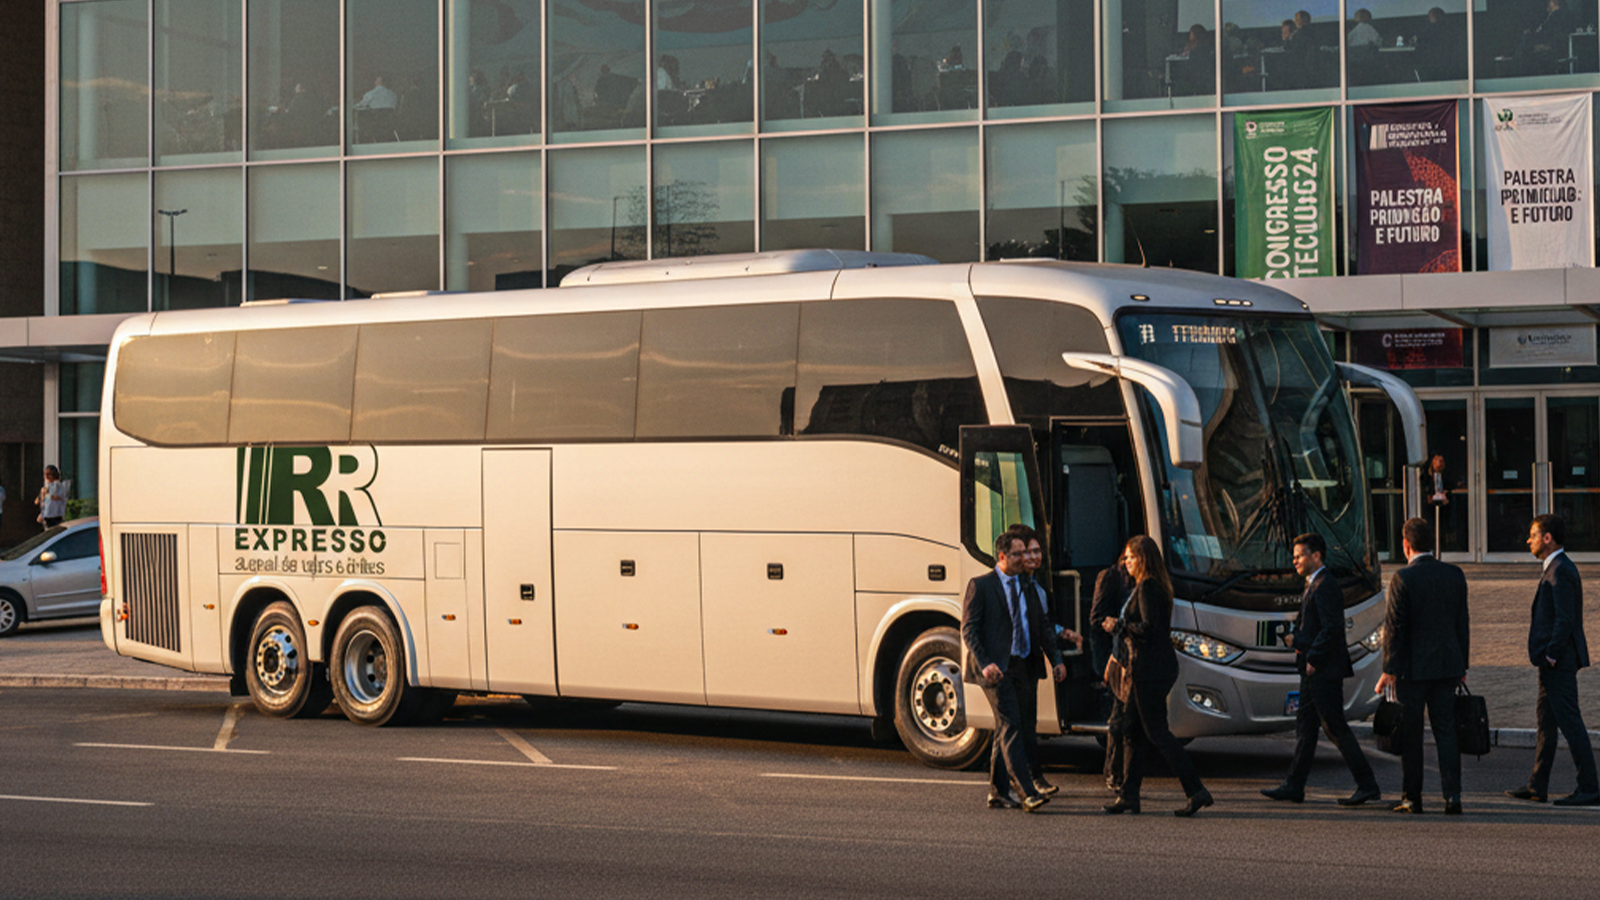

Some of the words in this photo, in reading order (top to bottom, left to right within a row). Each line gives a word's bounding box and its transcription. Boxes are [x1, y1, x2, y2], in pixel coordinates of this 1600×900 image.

[1503, 168, 1576, 185] PALESTRA
[1370, 187, 1443, 206] PALESTRA
[1511, 207, 1519, 224] E
[1376, 227, 1384, 244] E
[235, 528, 387, 553] EXPRESSO
